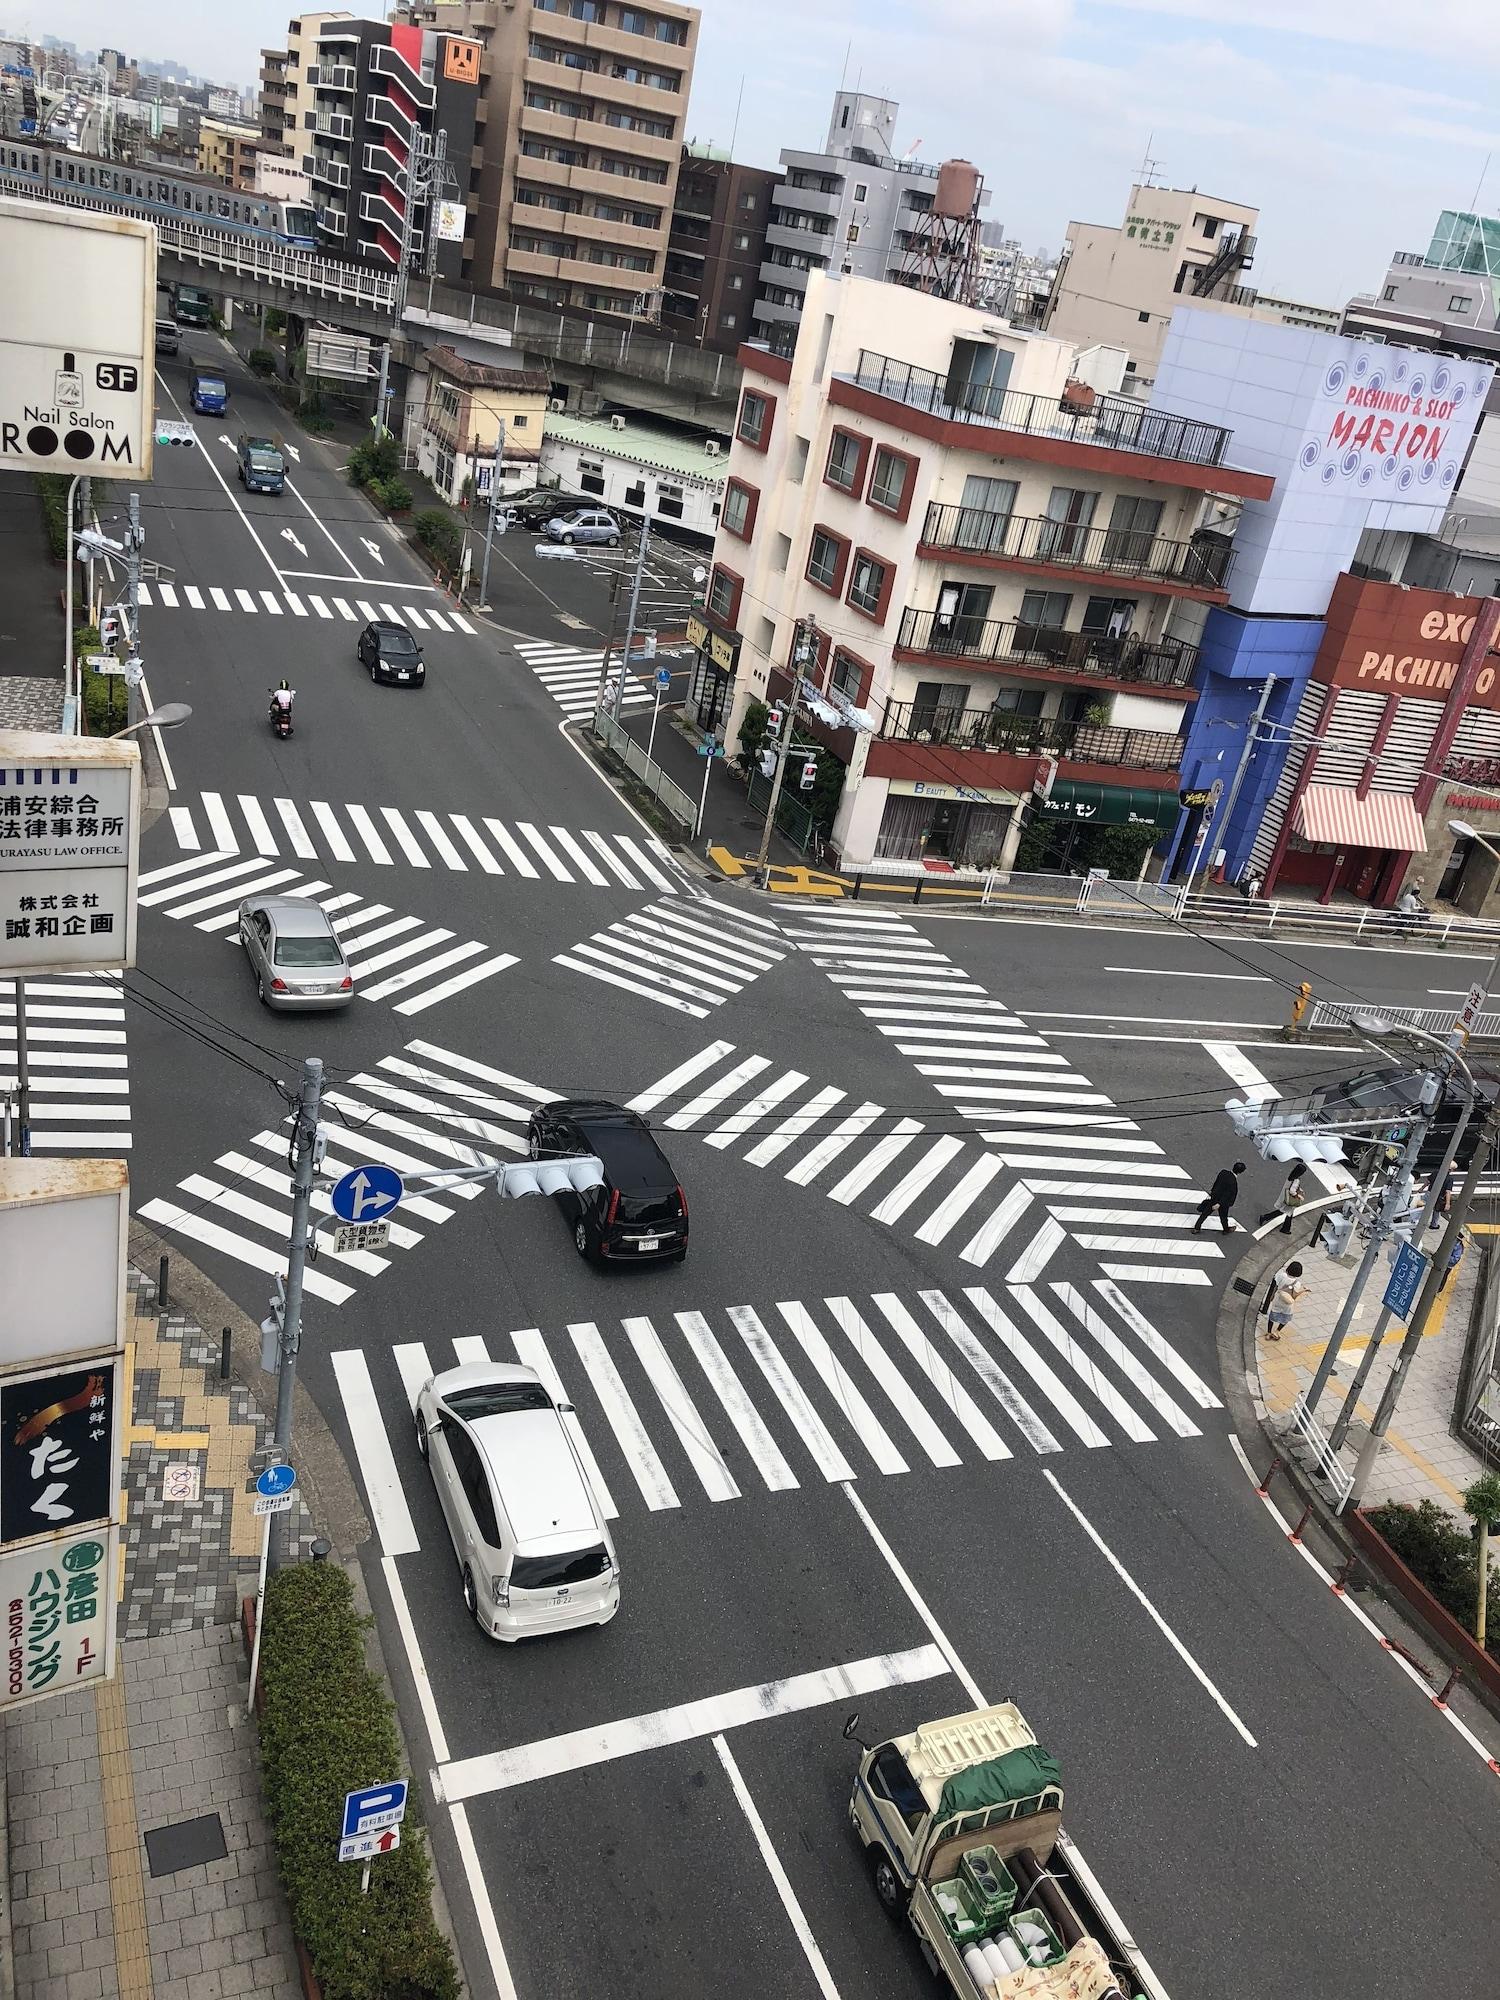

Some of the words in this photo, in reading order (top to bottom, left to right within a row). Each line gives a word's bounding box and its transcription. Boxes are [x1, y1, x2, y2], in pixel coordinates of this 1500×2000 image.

[97, 366, 135, 390] 5F
[24, 405, 60, 425] Nail
[69, 411, 114, 430] Salon
[1345, 386, 1410, 413] PACHINKO
[1412, 397, 1423, 417] &
[1425, 399, 1456, 421] SLOT
[1327, 410, 1450, 462] MARION
[1358, 651, 1496, 695] PACHINO
[0, 794, 99, 816] 浦安綜合
[1075, 803, 1097, 818] モン
[0, 816, 124, 839] 法律事務所
[54, 848, 78, 856] LAW
[19, 893, 99, 911] 株式会社
[5, 913, 114, 940] 誠和企画
[1461, 989, 1482, 1026] 注意
[89, 1394, 107, 1441] 新鮮や
[28, 1436, 80, 1520] たく
[64, 1572, 98, 1624] 彦田
[27, 1568, 61, 1689] ハウジング
[77, 1637, 96, 1675] 1F
[344, 1783, 406, 1836] P
[342, 1841, 374, 1856] 直進
